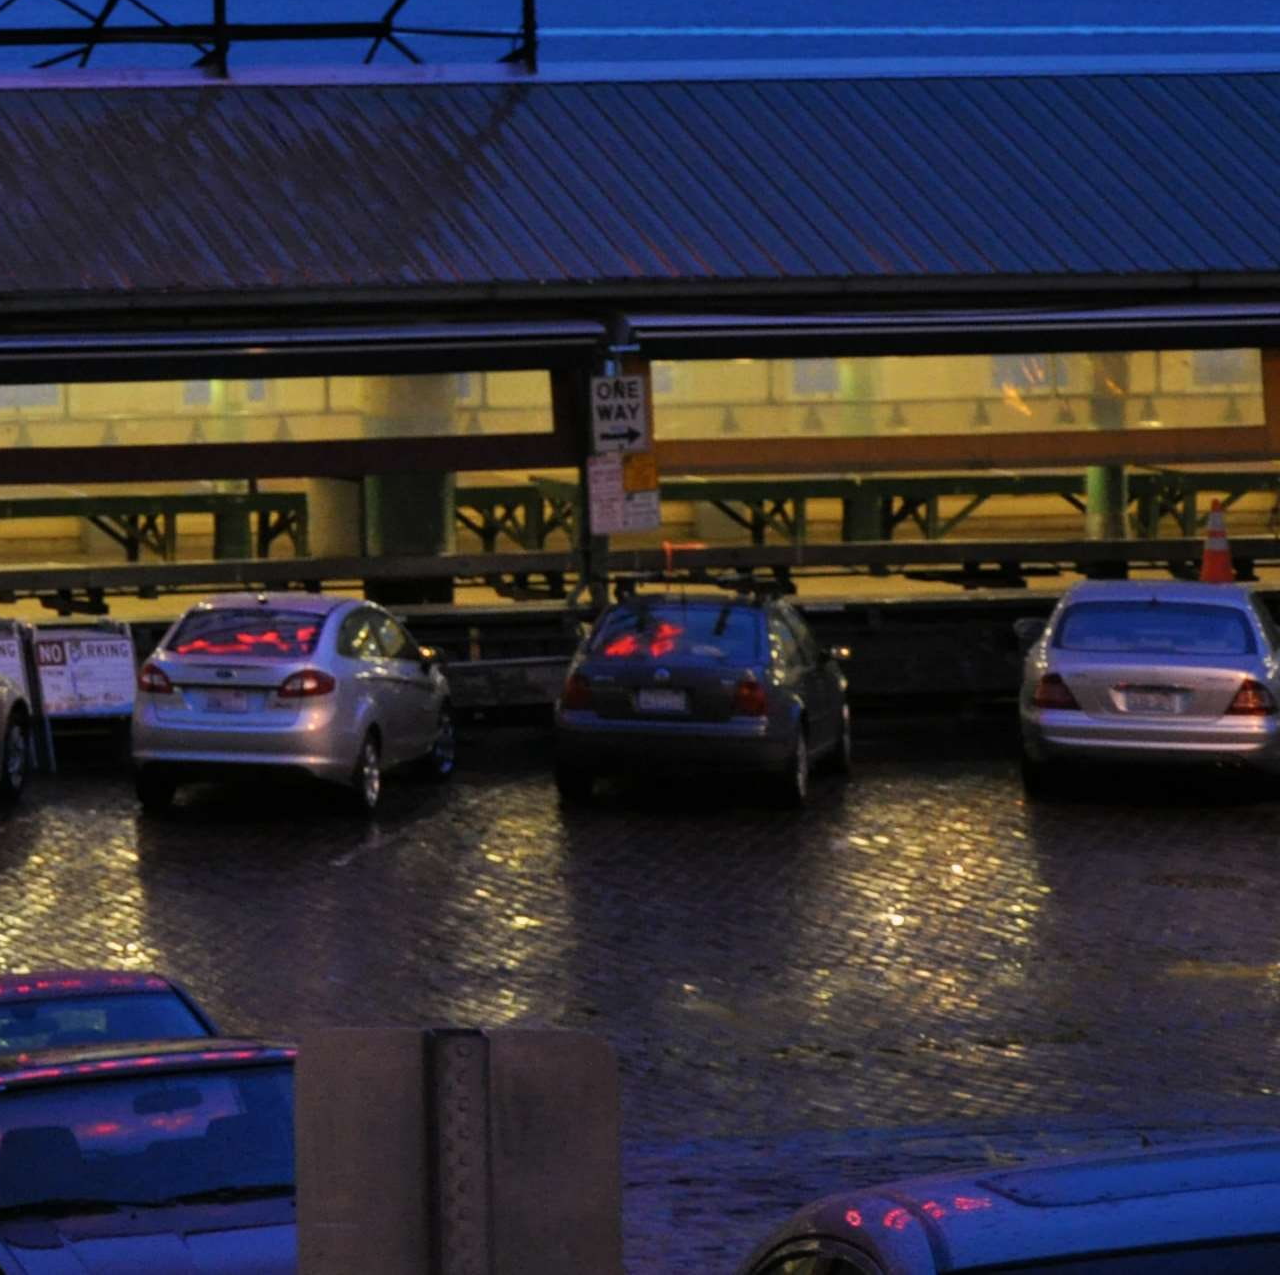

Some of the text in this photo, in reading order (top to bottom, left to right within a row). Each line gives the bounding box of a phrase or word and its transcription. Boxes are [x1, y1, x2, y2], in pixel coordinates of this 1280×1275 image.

[597, 381, 639, 399] ONE
[597, 404, 639, 420] WAY
[38, 643, 63, 663] NO
